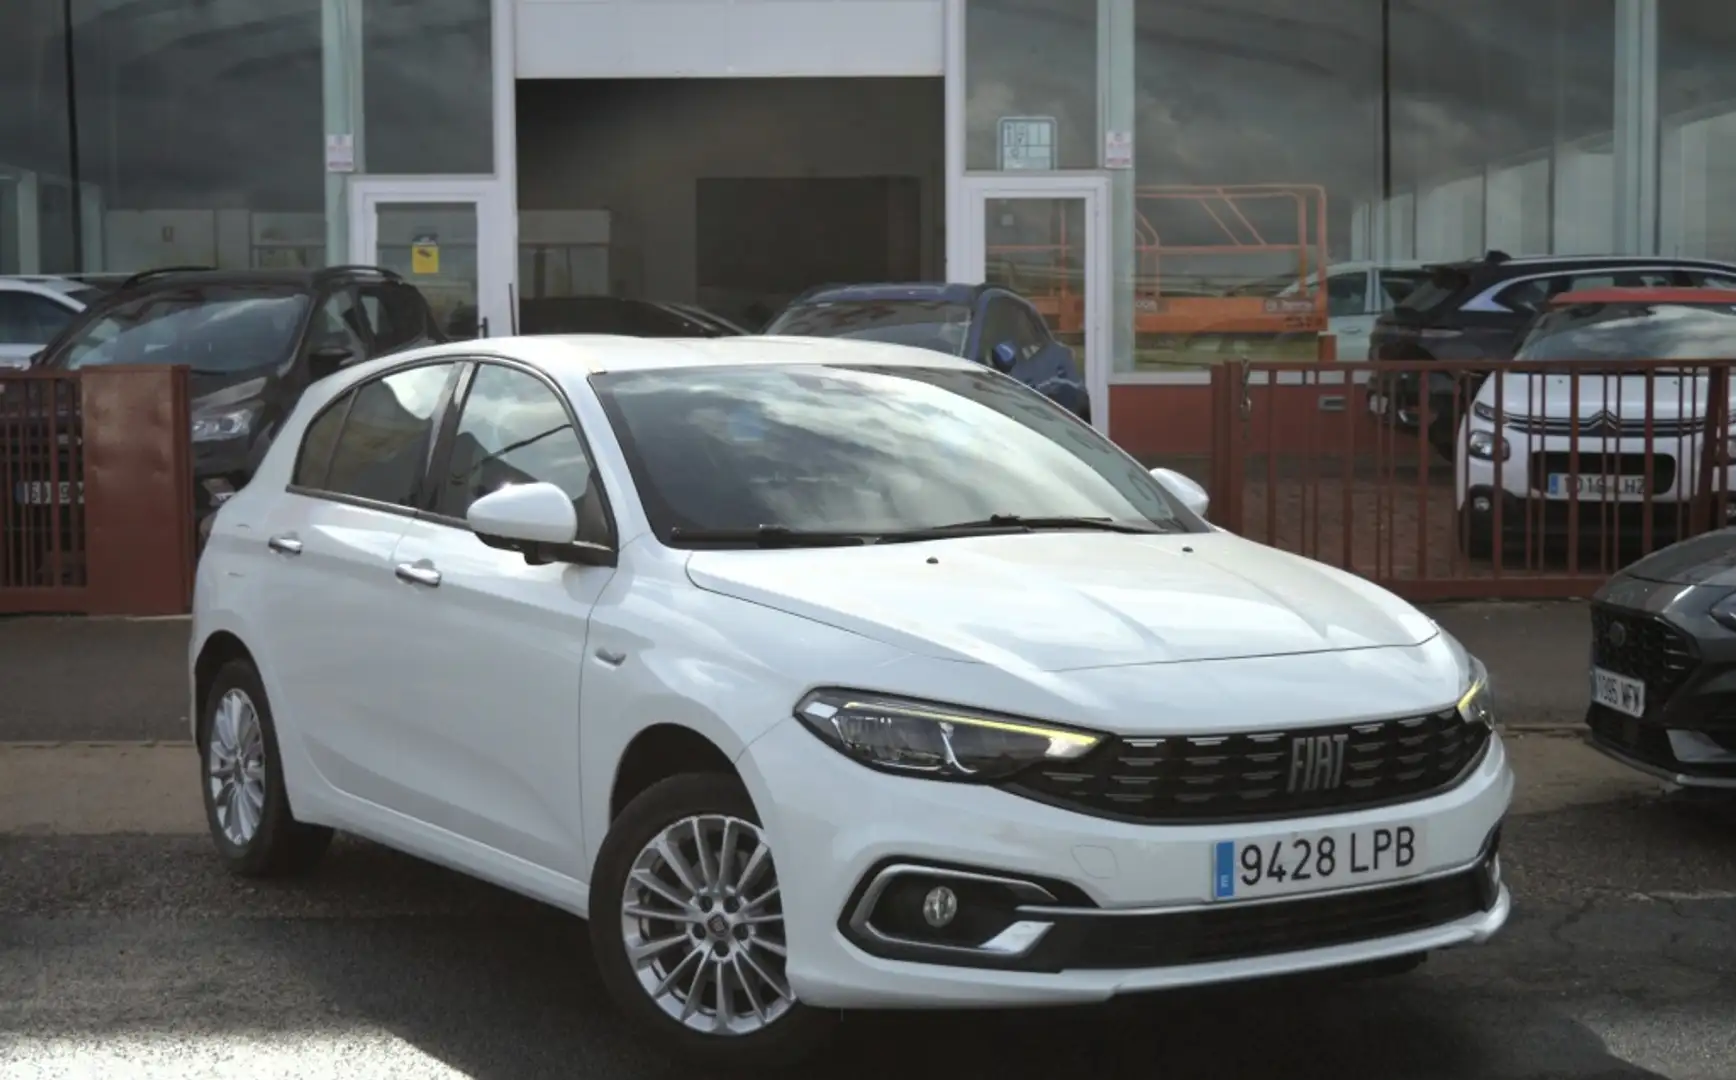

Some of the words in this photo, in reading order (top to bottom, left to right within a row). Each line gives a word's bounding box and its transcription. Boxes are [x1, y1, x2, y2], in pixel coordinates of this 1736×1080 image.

[1286, 733, 1349, 793] FIAT
[1240, 836, 1336, 886] 9428
[1350, 825, 1415, 873] LPB
